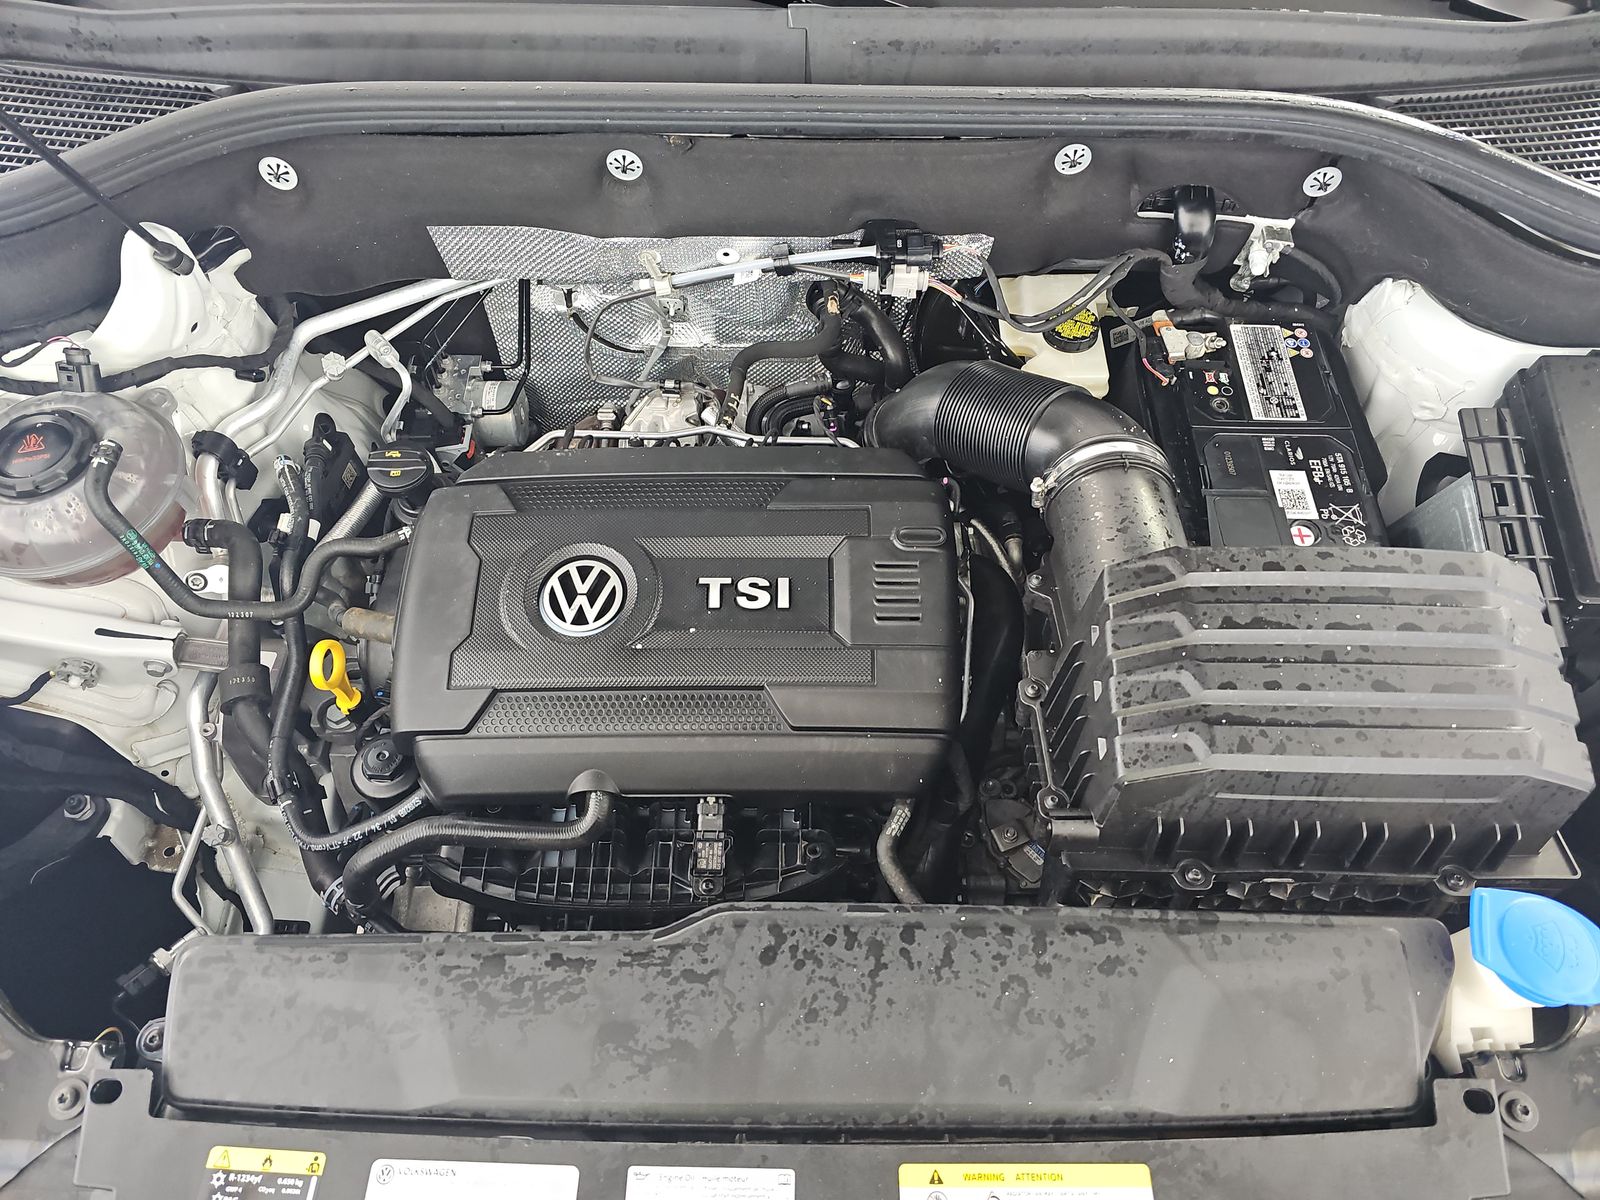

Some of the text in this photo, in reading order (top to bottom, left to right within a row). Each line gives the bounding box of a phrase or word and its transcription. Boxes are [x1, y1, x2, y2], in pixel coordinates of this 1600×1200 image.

[1284, 440, 1296, 466] CLARIOS
[1338, 464, 1348, 475] 915
[1342, 476, 1352, 487] 105
[1319, 508, 1331, 520] Pb
[697, 576, 791, 610] TSI
[398, 1167, 457, 1177] VOLKSWAGEN
[962, 1172, 1064, 1182] WARNING ATTENTION
